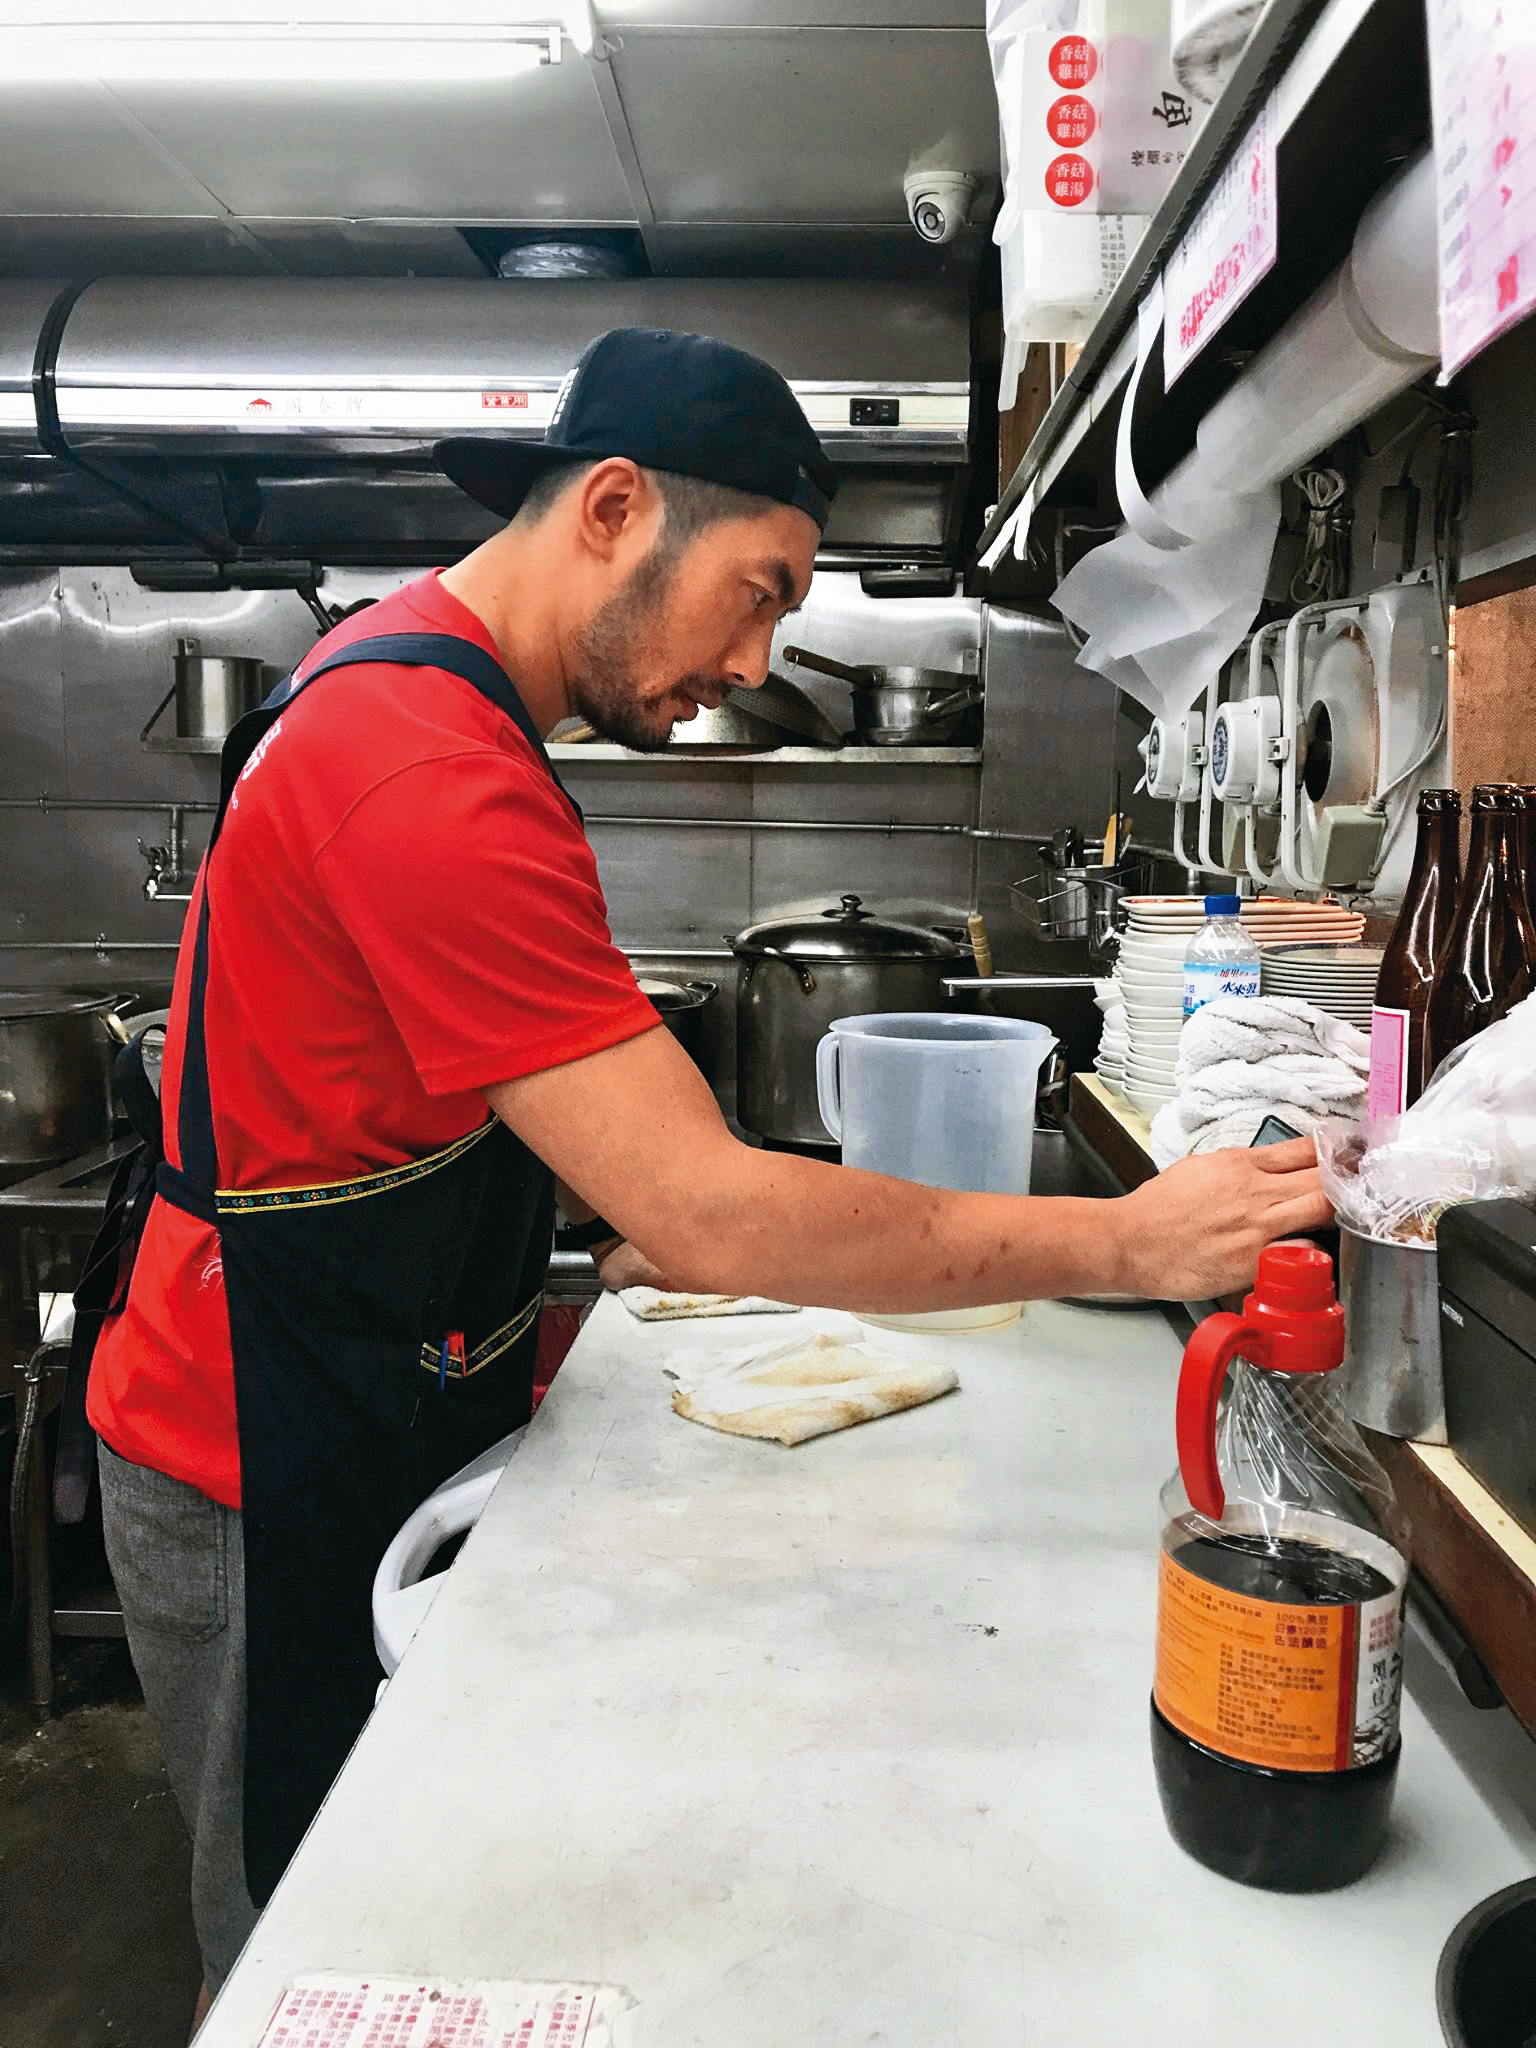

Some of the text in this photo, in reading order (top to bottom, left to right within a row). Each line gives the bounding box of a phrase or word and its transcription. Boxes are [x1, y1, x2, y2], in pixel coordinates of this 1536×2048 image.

[1060, 44, 1089, 61] 香菇
[1058, 63, 1089, 80] 雞湯
[1057, 103, 1088, 120] 香菇
[1056, 123, 1087, 138] 雞湯
[1055, 162, 1085, 178] 香菇
[1054, 181, 1084, 197] 雞湯
